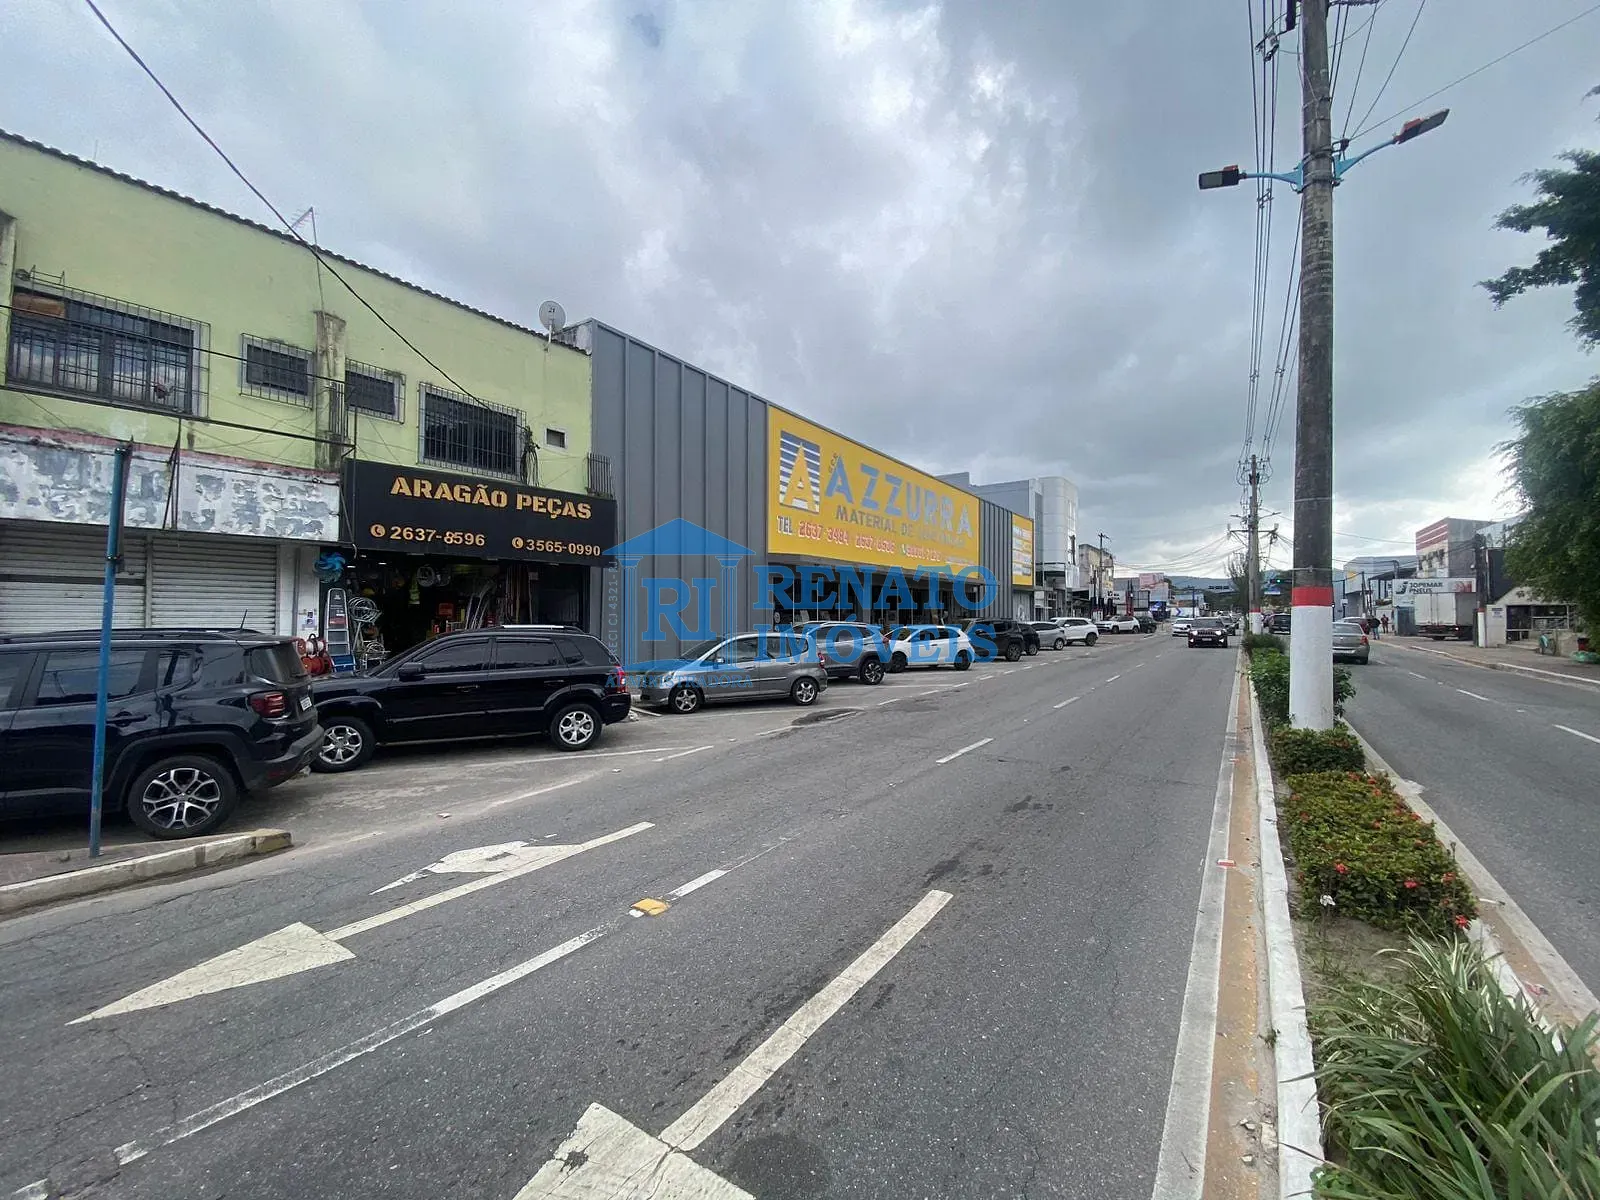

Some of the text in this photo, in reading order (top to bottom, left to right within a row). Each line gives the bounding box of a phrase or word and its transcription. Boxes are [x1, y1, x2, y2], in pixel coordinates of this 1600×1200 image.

[390, 476, 592, 519] ARAGÃO PEÇAS
[825, 455, 973, 538] AZZURRA
[777, 515, 793, 535] TEL
[836, 505, 897, 533] MATERIAL
[390, 525, 600, 556] 2637-8596 3565-0990
